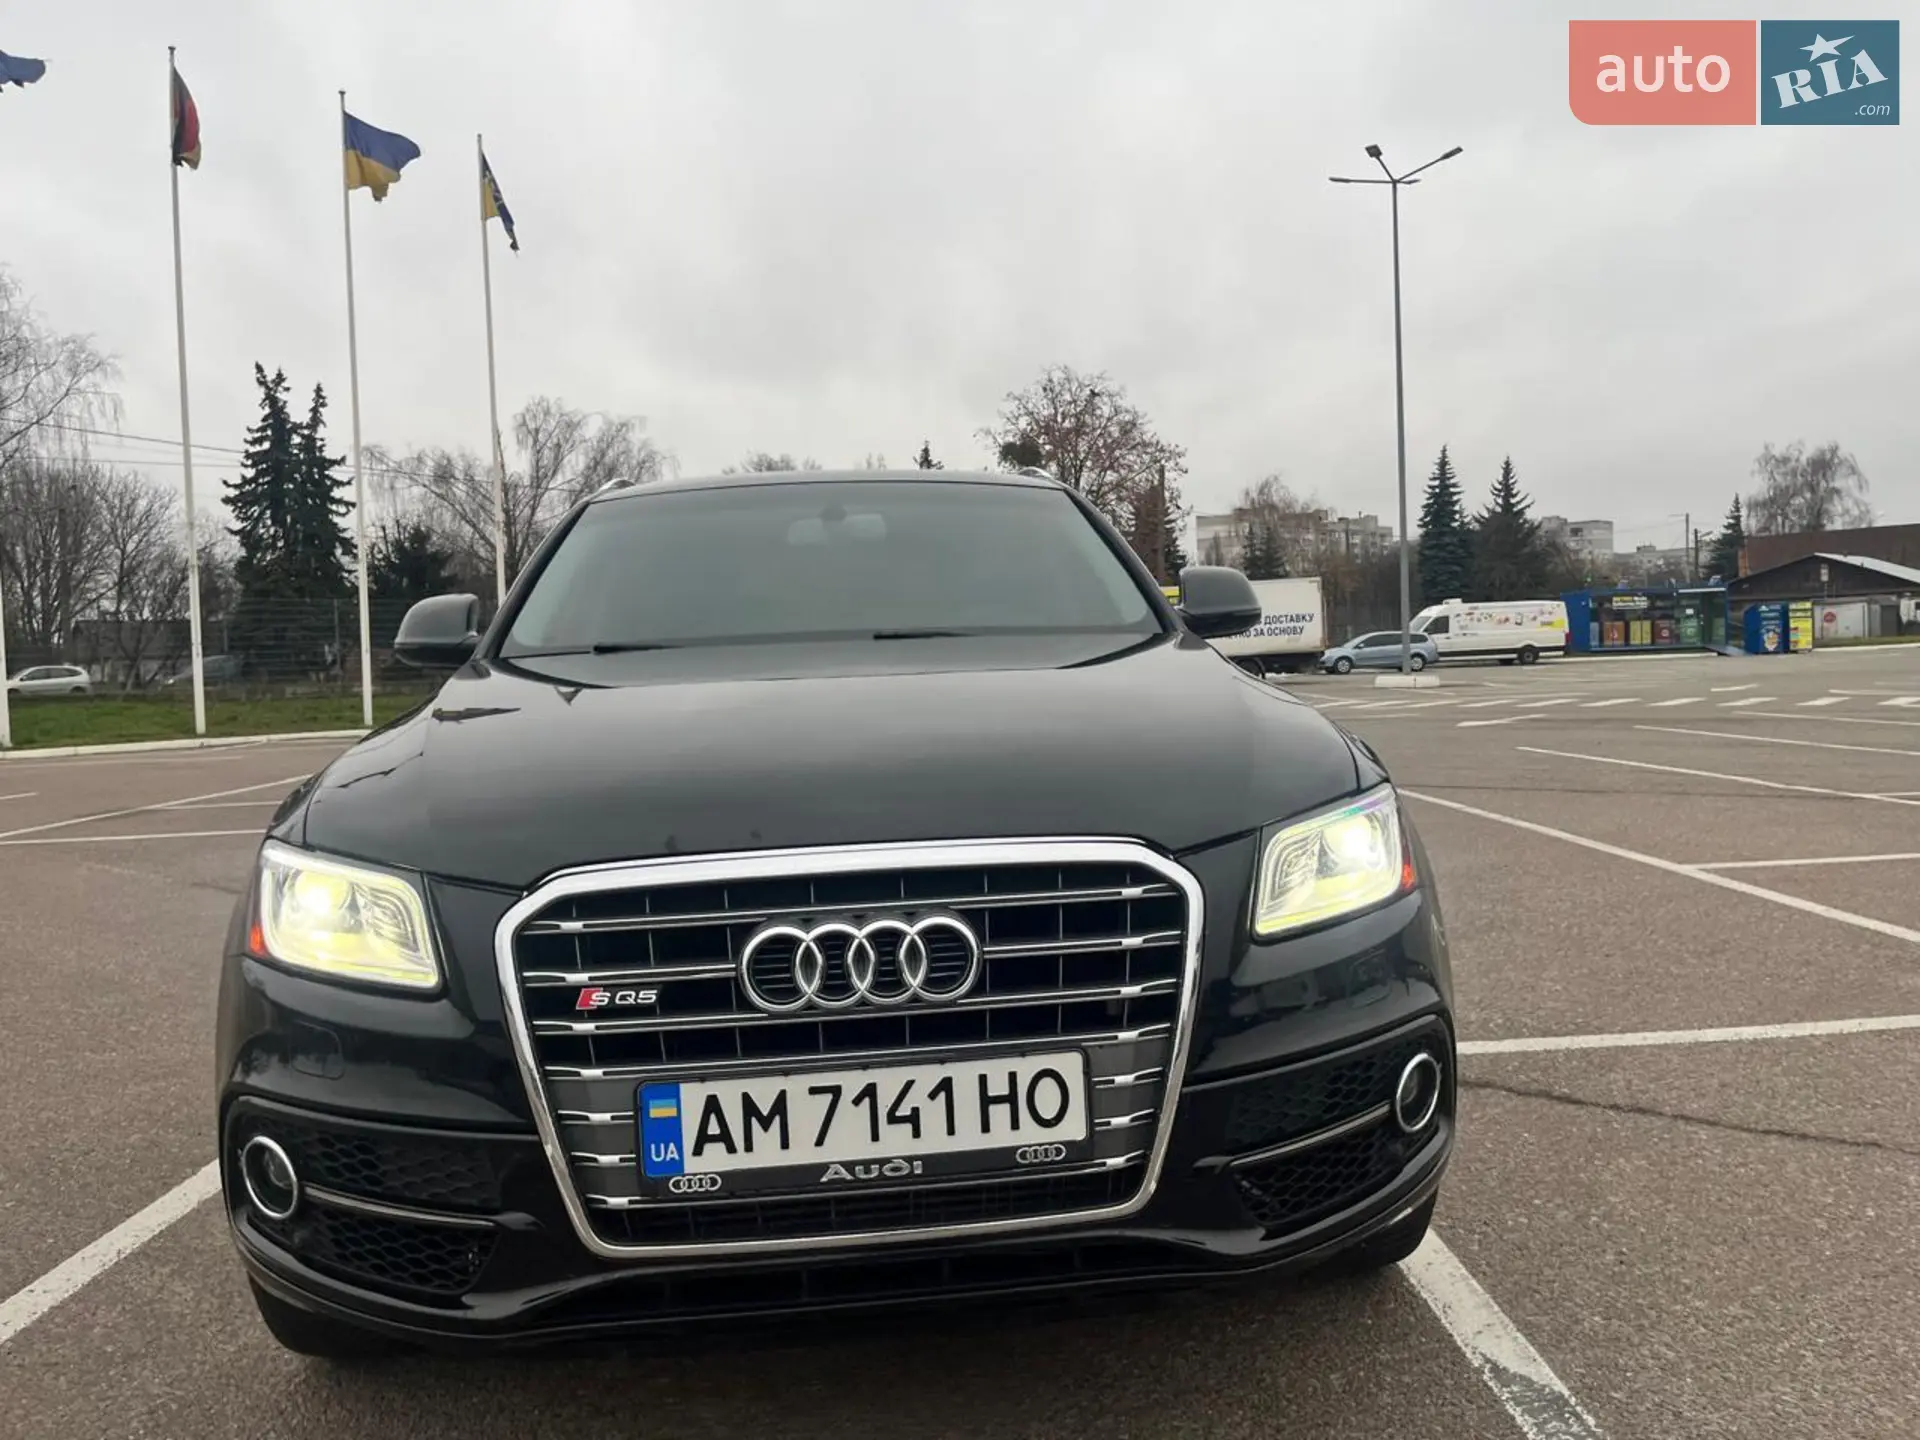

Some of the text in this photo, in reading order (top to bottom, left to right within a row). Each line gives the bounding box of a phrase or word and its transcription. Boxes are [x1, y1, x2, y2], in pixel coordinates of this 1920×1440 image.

[1264, 613, 1314, 625] ДОСТАВКУ
[1253, 628, 1265, 637] ЗА
[1267, 625, 1304, 637] ОСНОВУ
[691, 1067, 1070, 1157] AM 7141 HO
[651, 1143, 680, 1163] UA
[820, 1159, 923, 1183] Audi
